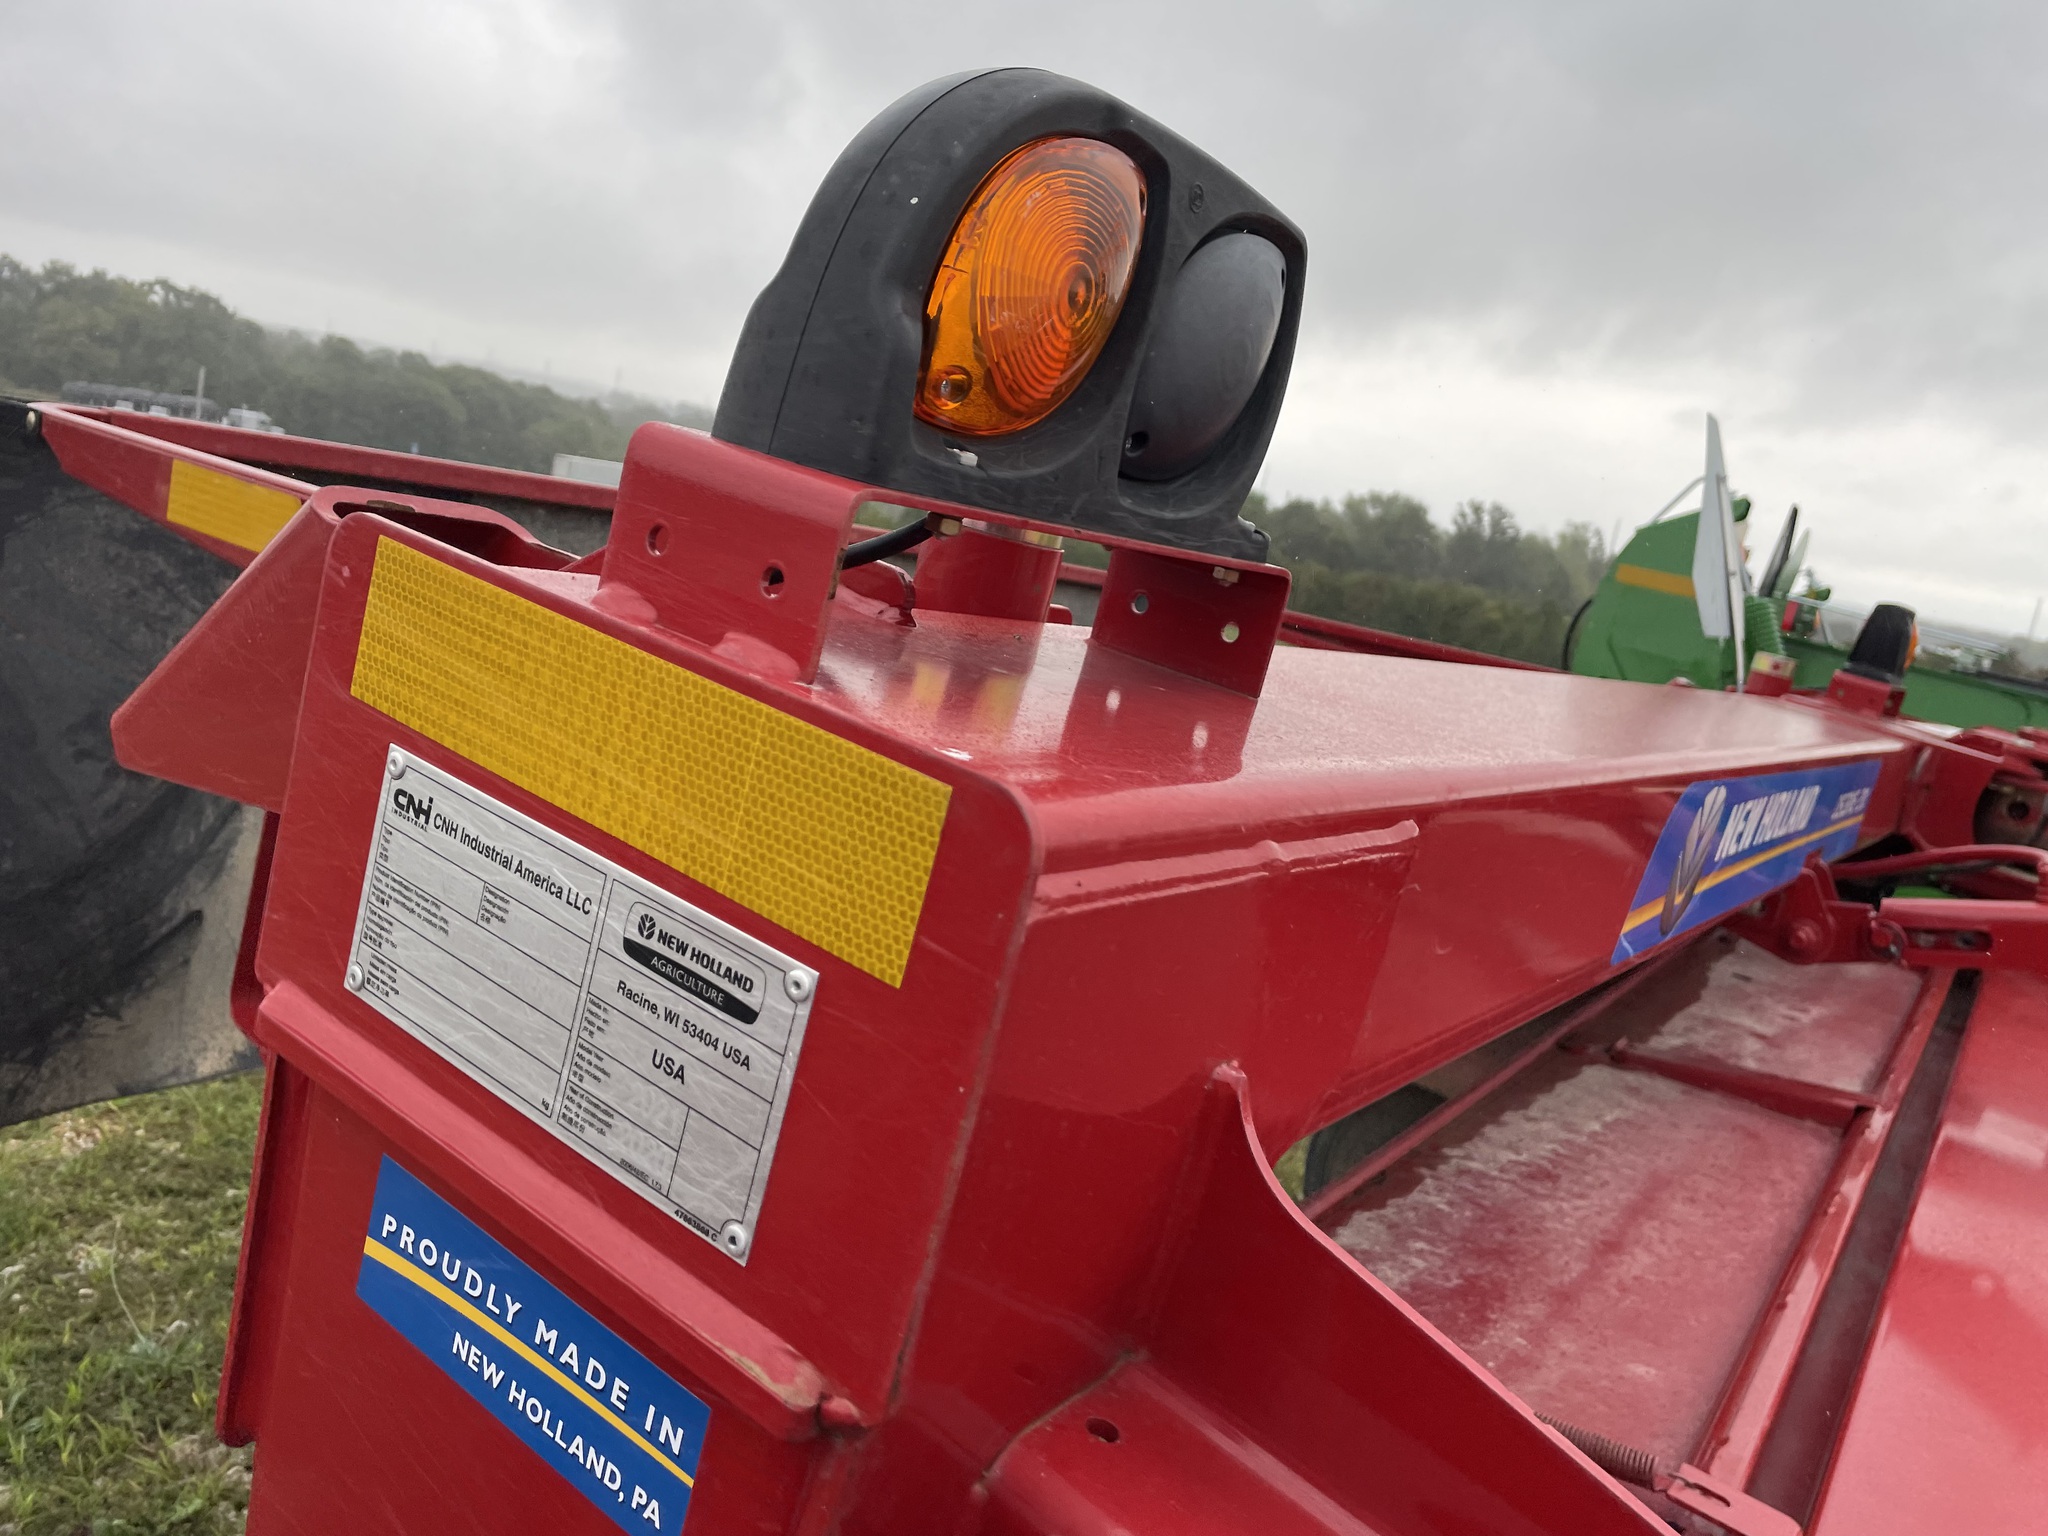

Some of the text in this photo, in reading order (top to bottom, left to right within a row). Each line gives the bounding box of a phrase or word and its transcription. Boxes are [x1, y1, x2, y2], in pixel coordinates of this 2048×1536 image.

[390, 806, 427, 832] INDUSTRIAL
[1714, 796, 1768, 862] NEW
[1752, 785, 1820, 846] HOLLAND
[432, 811, 593, 916] CNH Industrial America LLC
[650, 953, 725, 1006] AGRICULTURE
[656, 927, 754, 995] NEW HOLLAND
[615, 978, 753, 1072] Racine, WI 53404 USA
[650, 1047, 688, 1085] USA
[540, 1097, 550, 1112] kg
[710, 1231, 717, 1243] C
[382, 1213, 685, 1457] PROUDLY MADE IN
[451, 1331, 662, 1530] NEW HOLLAND, PA
